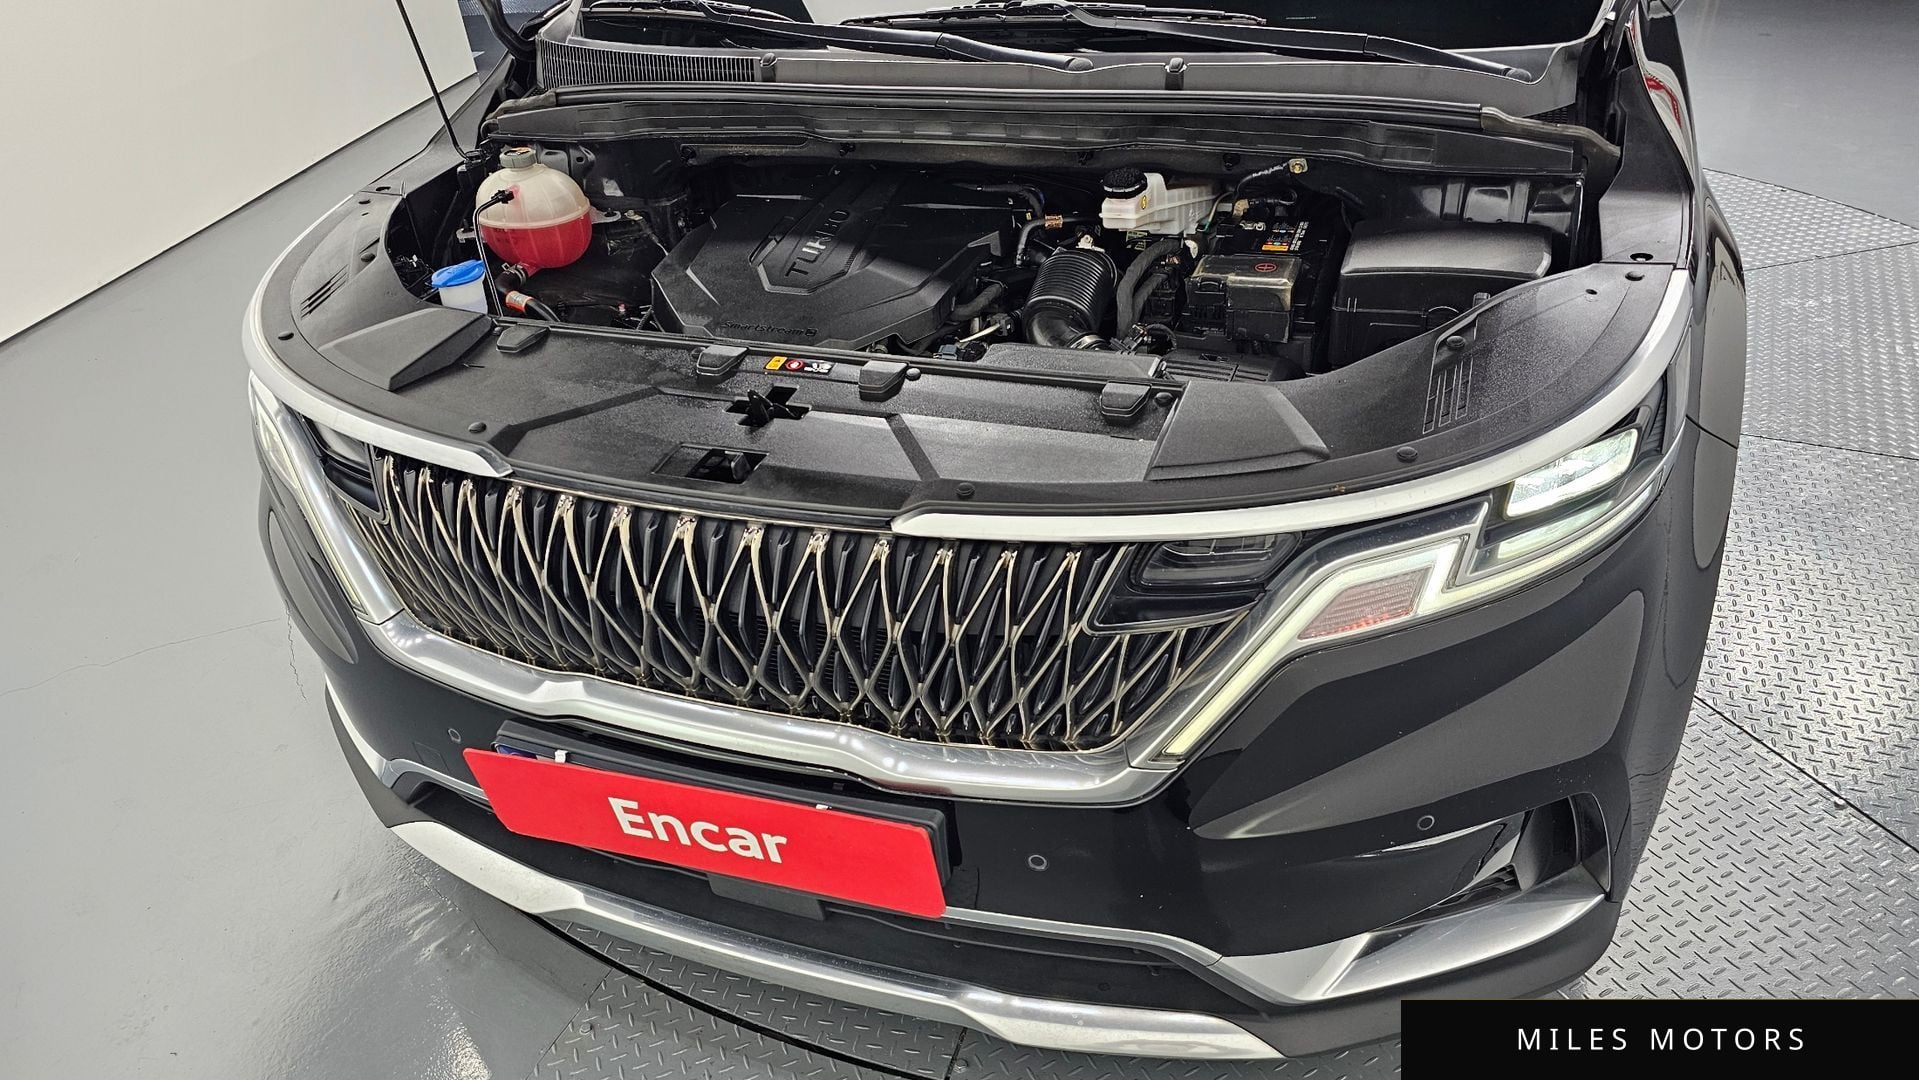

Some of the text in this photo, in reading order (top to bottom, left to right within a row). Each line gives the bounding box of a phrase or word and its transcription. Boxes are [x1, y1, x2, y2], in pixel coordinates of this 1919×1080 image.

[784, 208, 850, 277] TURBO
[721, 320, 805, 336] Smartstream
[607, 796, 788, 864] Encar
